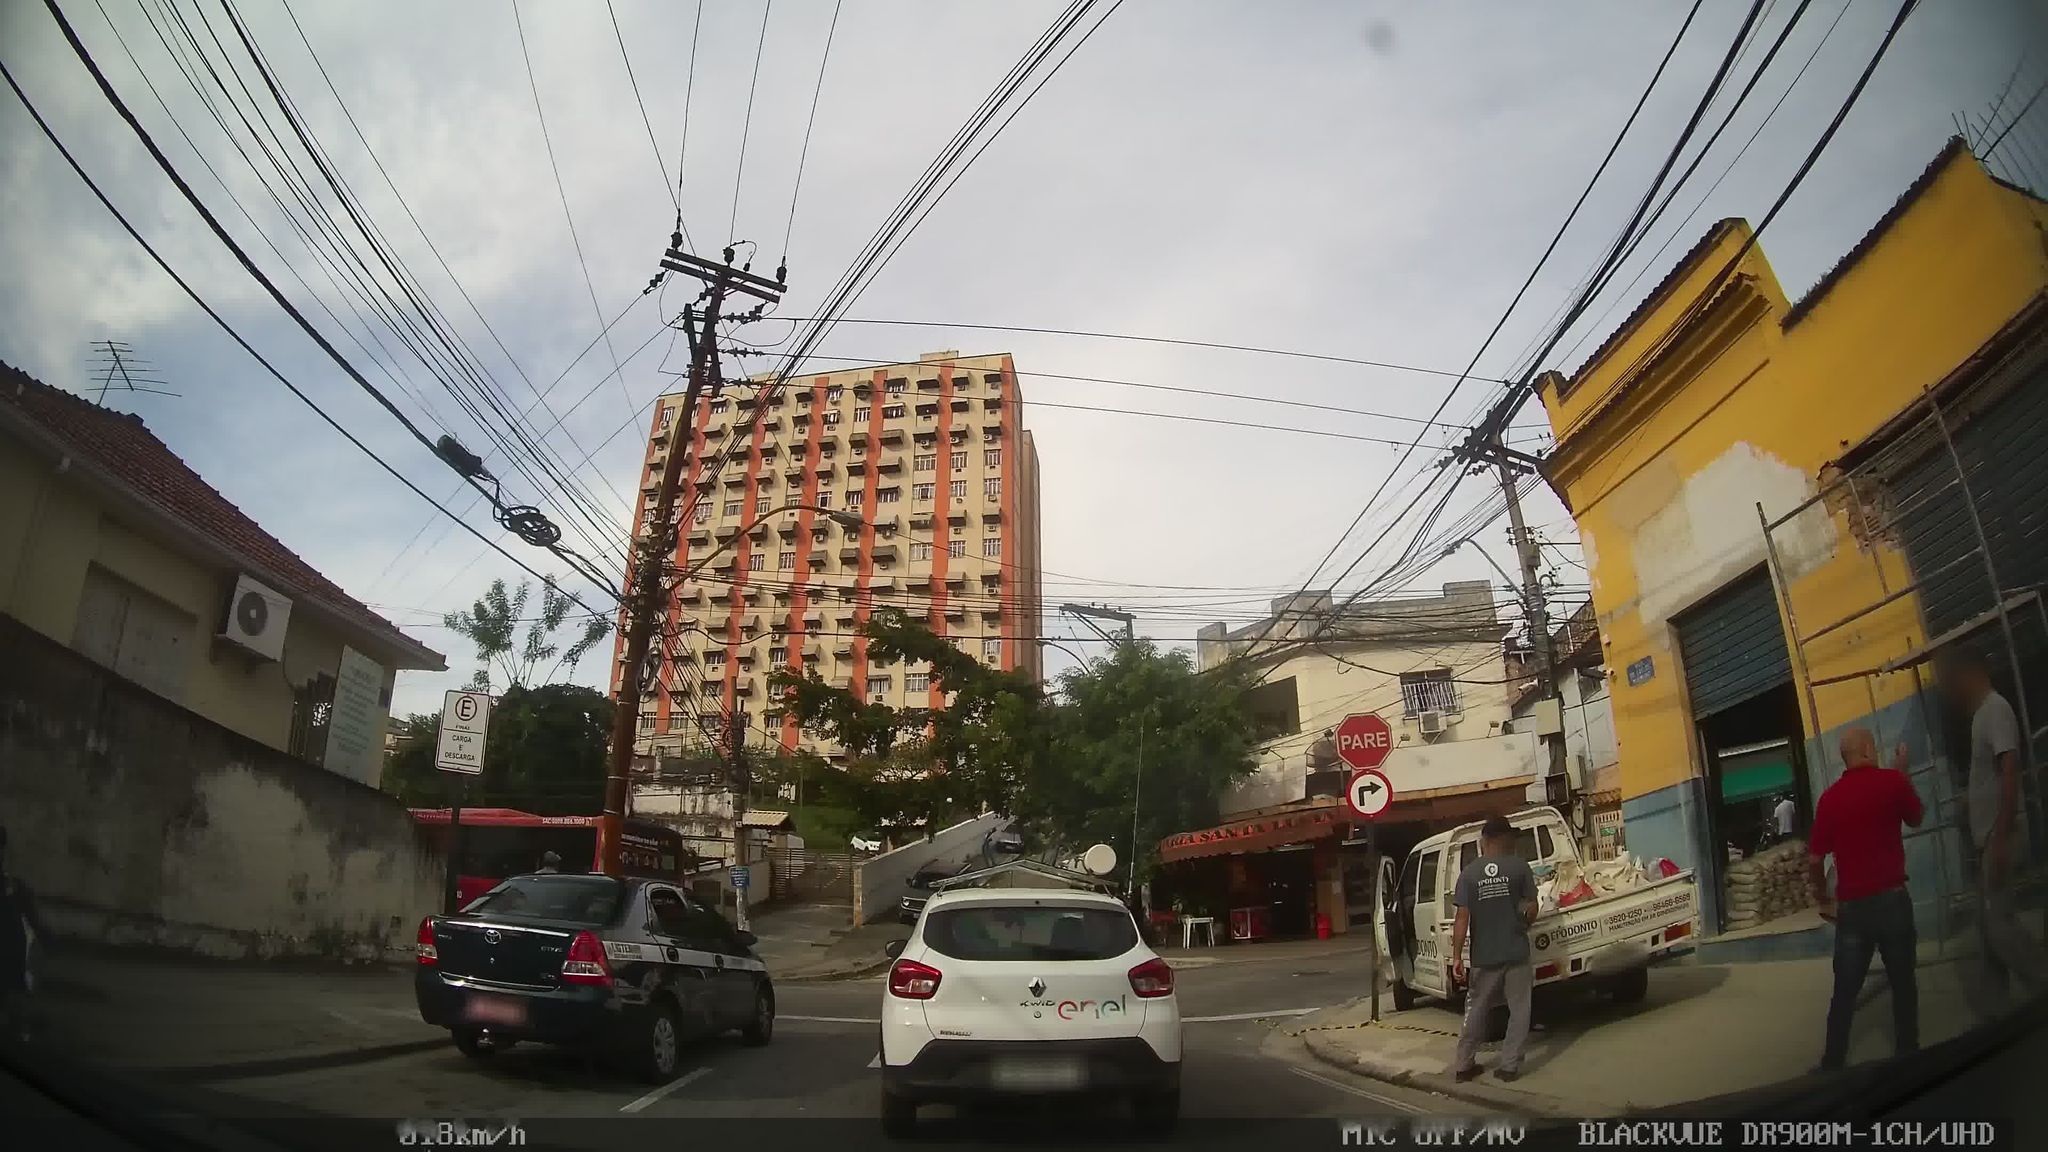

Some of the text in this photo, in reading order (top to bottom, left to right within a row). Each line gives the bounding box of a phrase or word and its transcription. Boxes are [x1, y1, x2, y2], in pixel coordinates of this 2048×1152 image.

[451, 734, 473, 743] CARGA
[1340, 731, 1388, 751] PARE
[444, 751, 476, 761] DESCARGA
[1058, 994, 1126, 1020] enel
